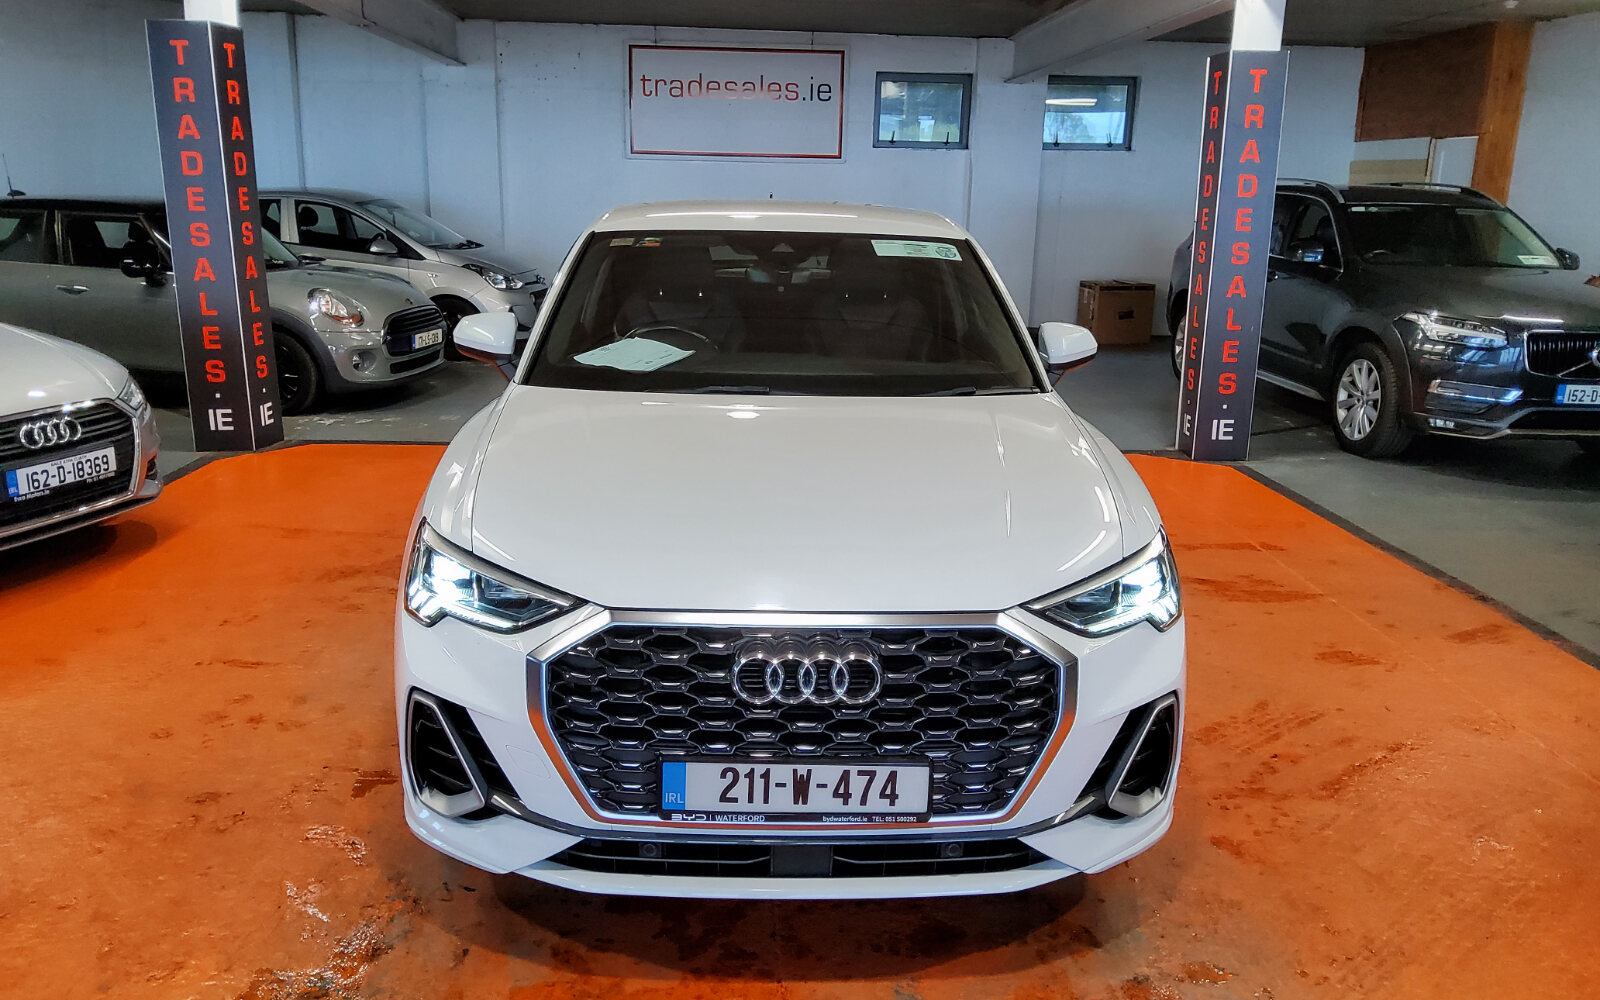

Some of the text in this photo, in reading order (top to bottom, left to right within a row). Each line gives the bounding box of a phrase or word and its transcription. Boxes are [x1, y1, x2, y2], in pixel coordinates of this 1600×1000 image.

[640, 73, 832, 102] tradesales.ie
[26, 454, 110, 492] 162-D-18369
[719, 766, 899, 807] 211-W-474
[665, 792, 684, 804] IRL
[715, 814, 765, 822] WATERFORD
[822, 815, 868, 823] bydwaterford.ie
